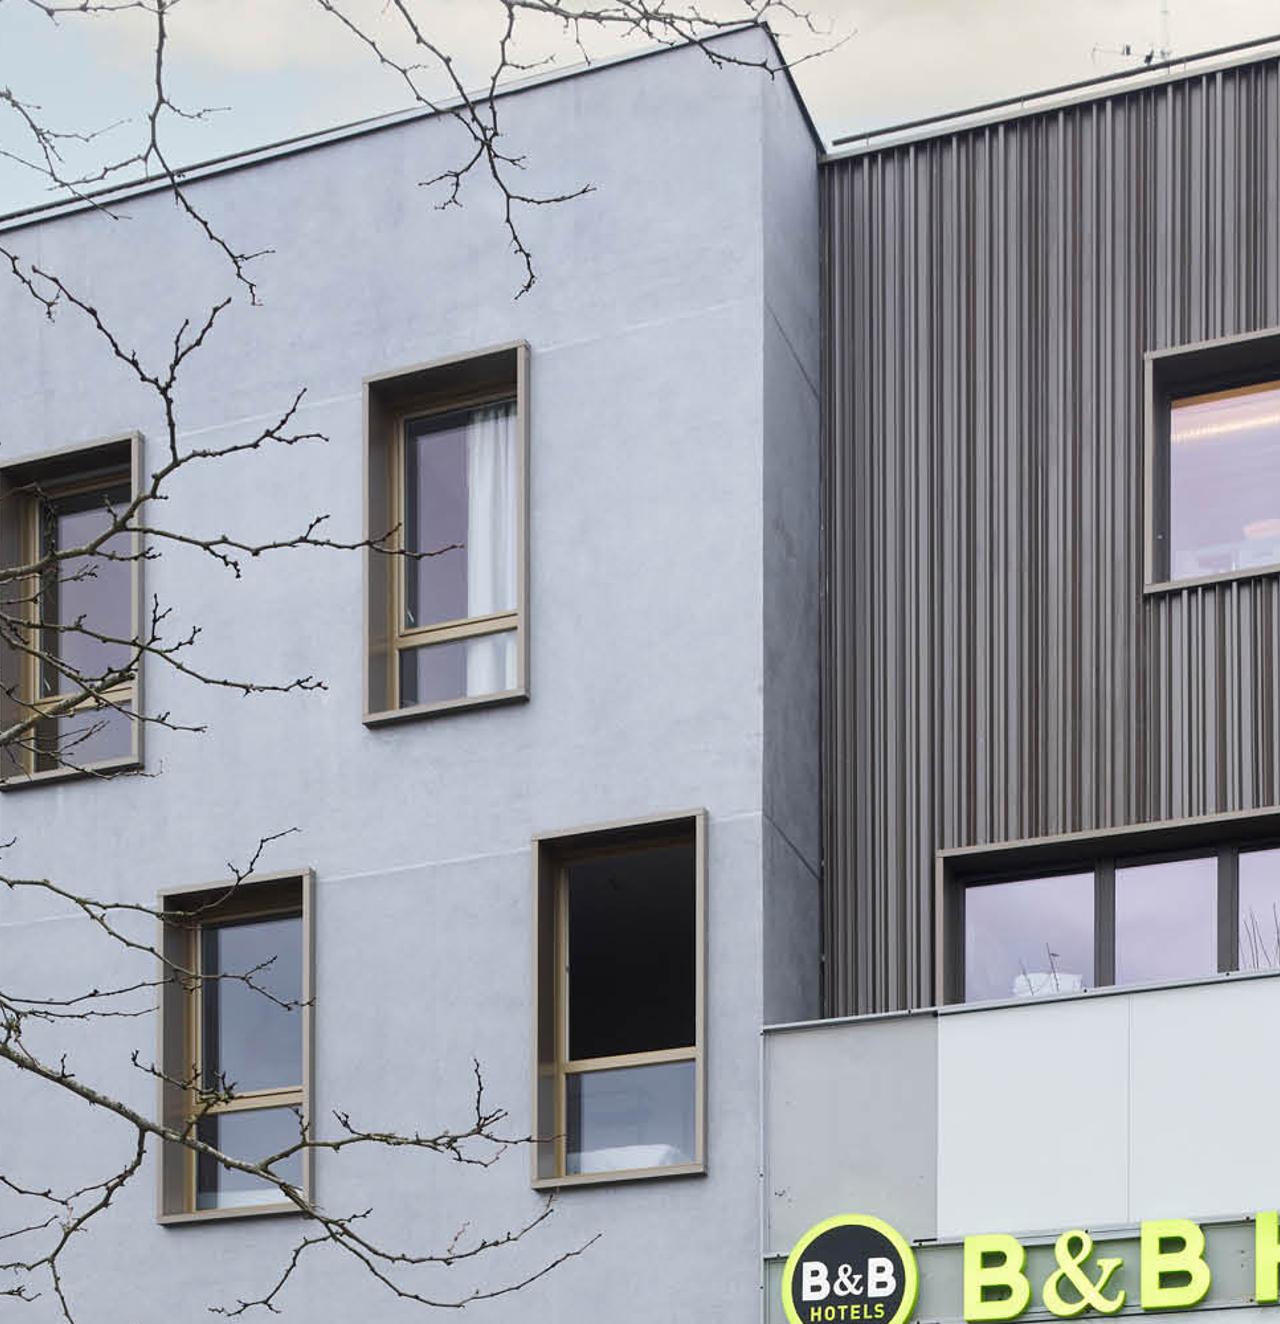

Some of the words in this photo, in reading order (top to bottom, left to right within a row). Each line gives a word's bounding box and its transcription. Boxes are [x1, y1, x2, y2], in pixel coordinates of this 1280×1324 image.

[802, 1257, 897, 1301] B&B
[962, 1218, 1213, 1323] B&B
[809, 1303, 886, 1322] HOTELS
